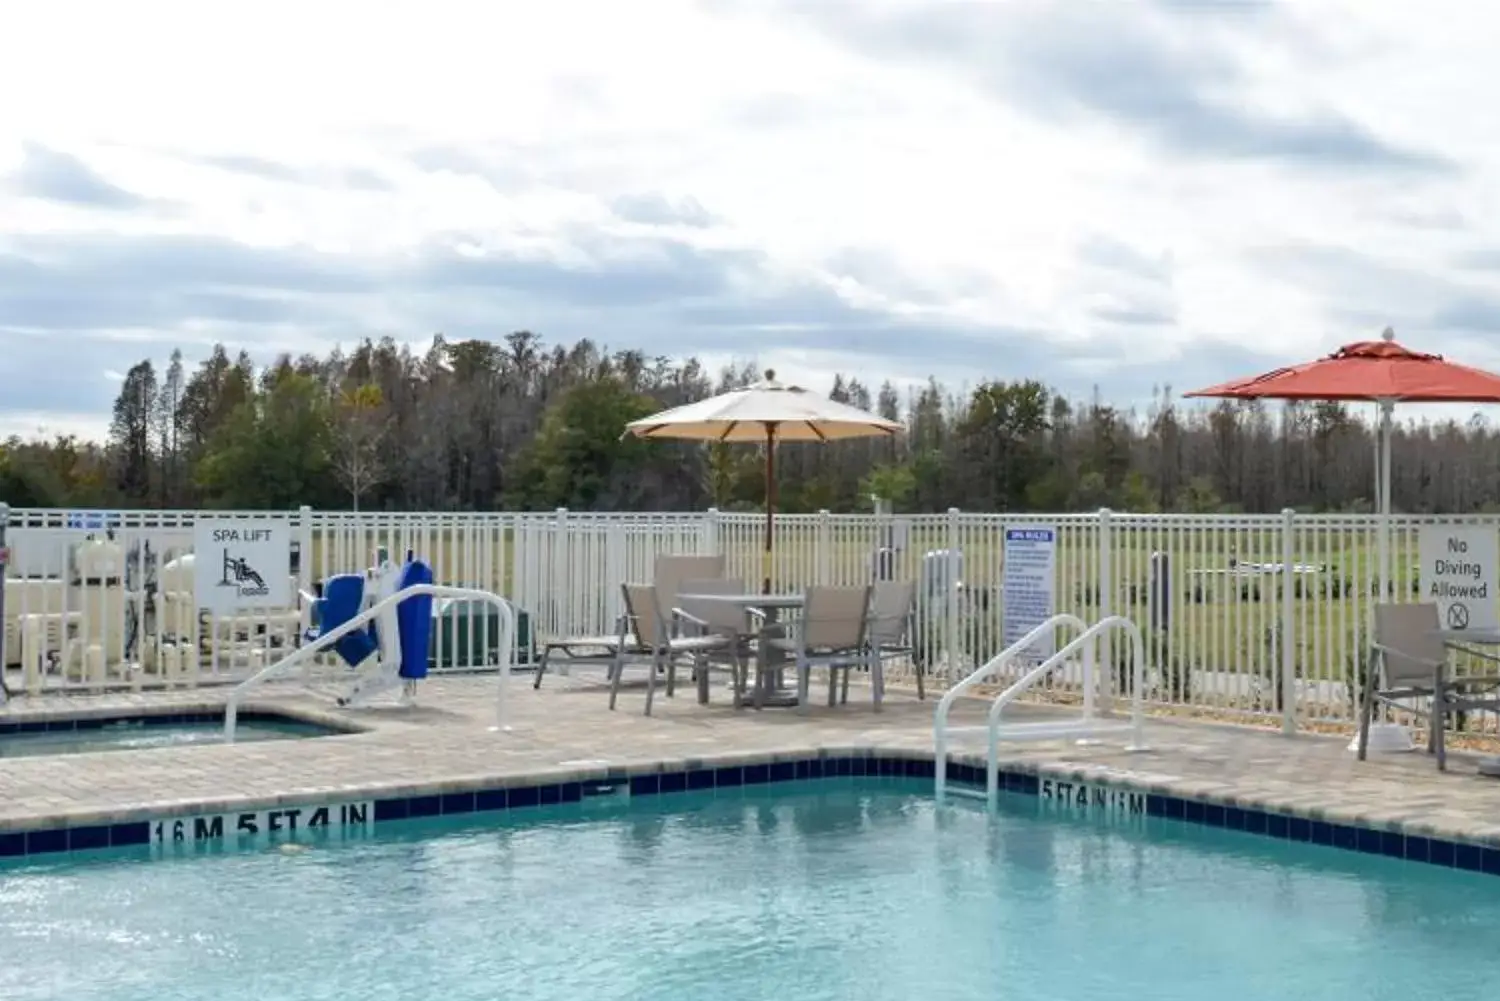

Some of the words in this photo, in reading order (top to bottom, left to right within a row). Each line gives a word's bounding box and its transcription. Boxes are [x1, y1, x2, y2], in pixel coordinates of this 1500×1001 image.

[212, 529, 239, 541] SPA
[244, 529, 272, 541] LIFT
[1447, 537, 1468, 553] No
[1435, 559, 1481, 579] Diving
[1431, 582, 1487, 598] Allowed
[1043, 780, 1052, 798] 5
[194, 816, 223, 839] M
[237, 813, 258, 834] 5
[268, 810, 301, 831] FT
[308, 807, 329, 826] 4
[341, 803, 367, 824] IN
